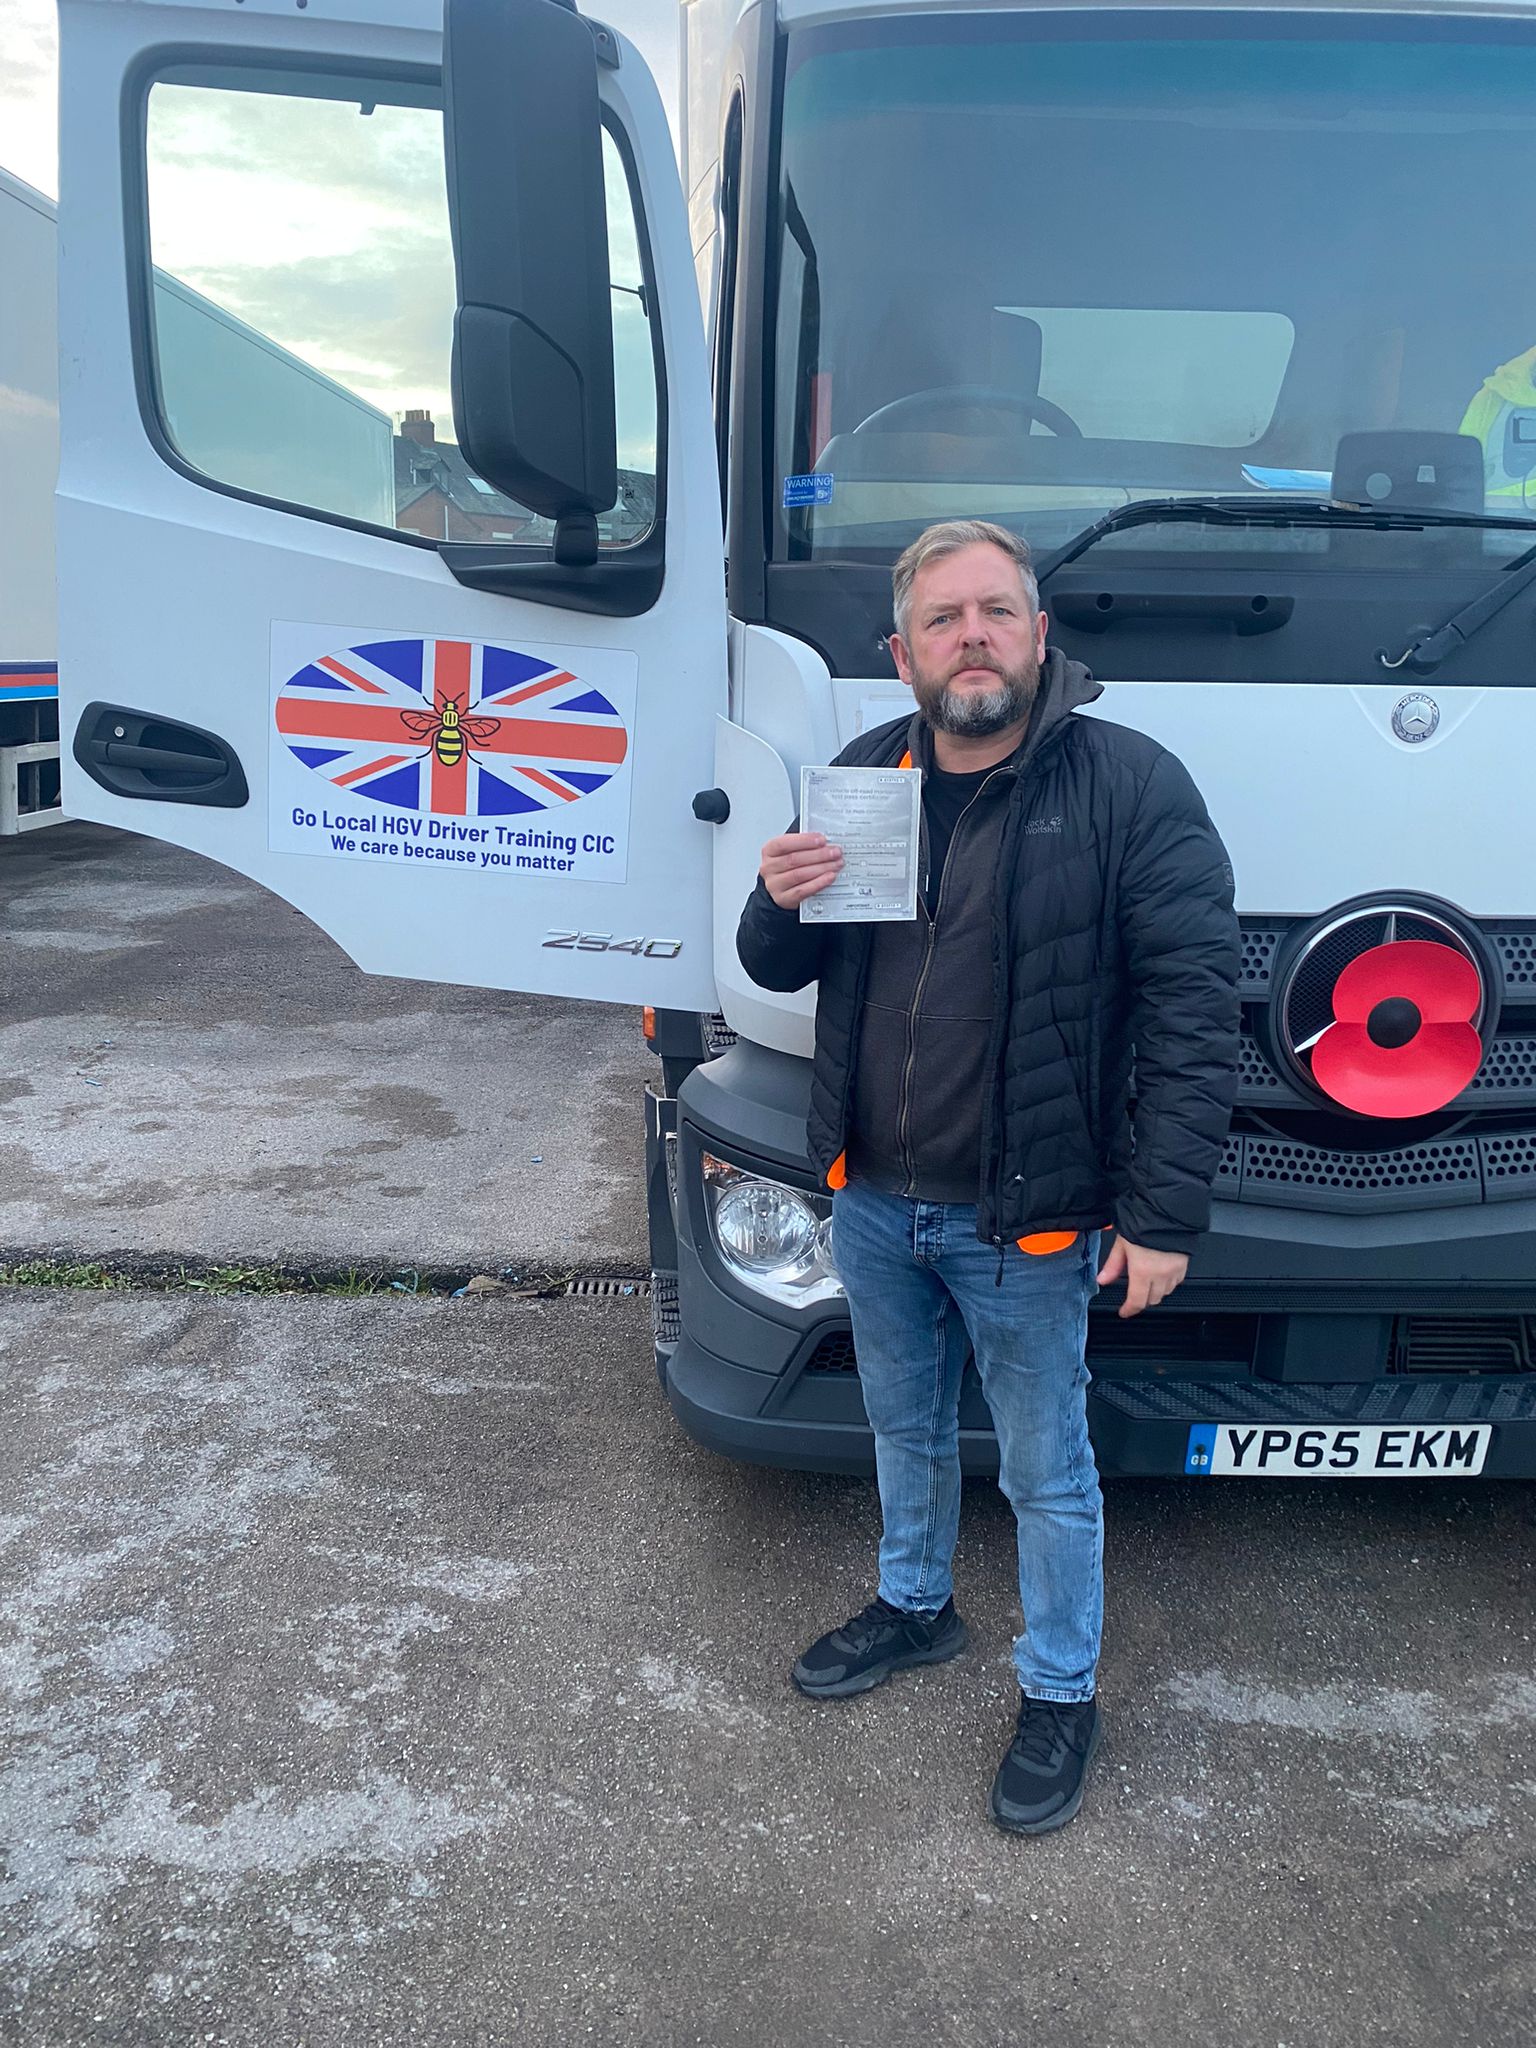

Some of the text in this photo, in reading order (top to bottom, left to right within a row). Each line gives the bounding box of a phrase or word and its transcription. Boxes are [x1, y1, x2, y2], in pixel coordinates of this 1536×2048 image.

[787, 476, 831, 488] WARNING
[292, 807, 615, 855] Go Local HGV Driver Training CIC
[330, 834, 575, 872] We care because you matter
[542, 928, 684, 959] 2540
[1190, 1455, 1209, 1466] GB
[1228, 1429, 1481, 1468] YP65 EKM
